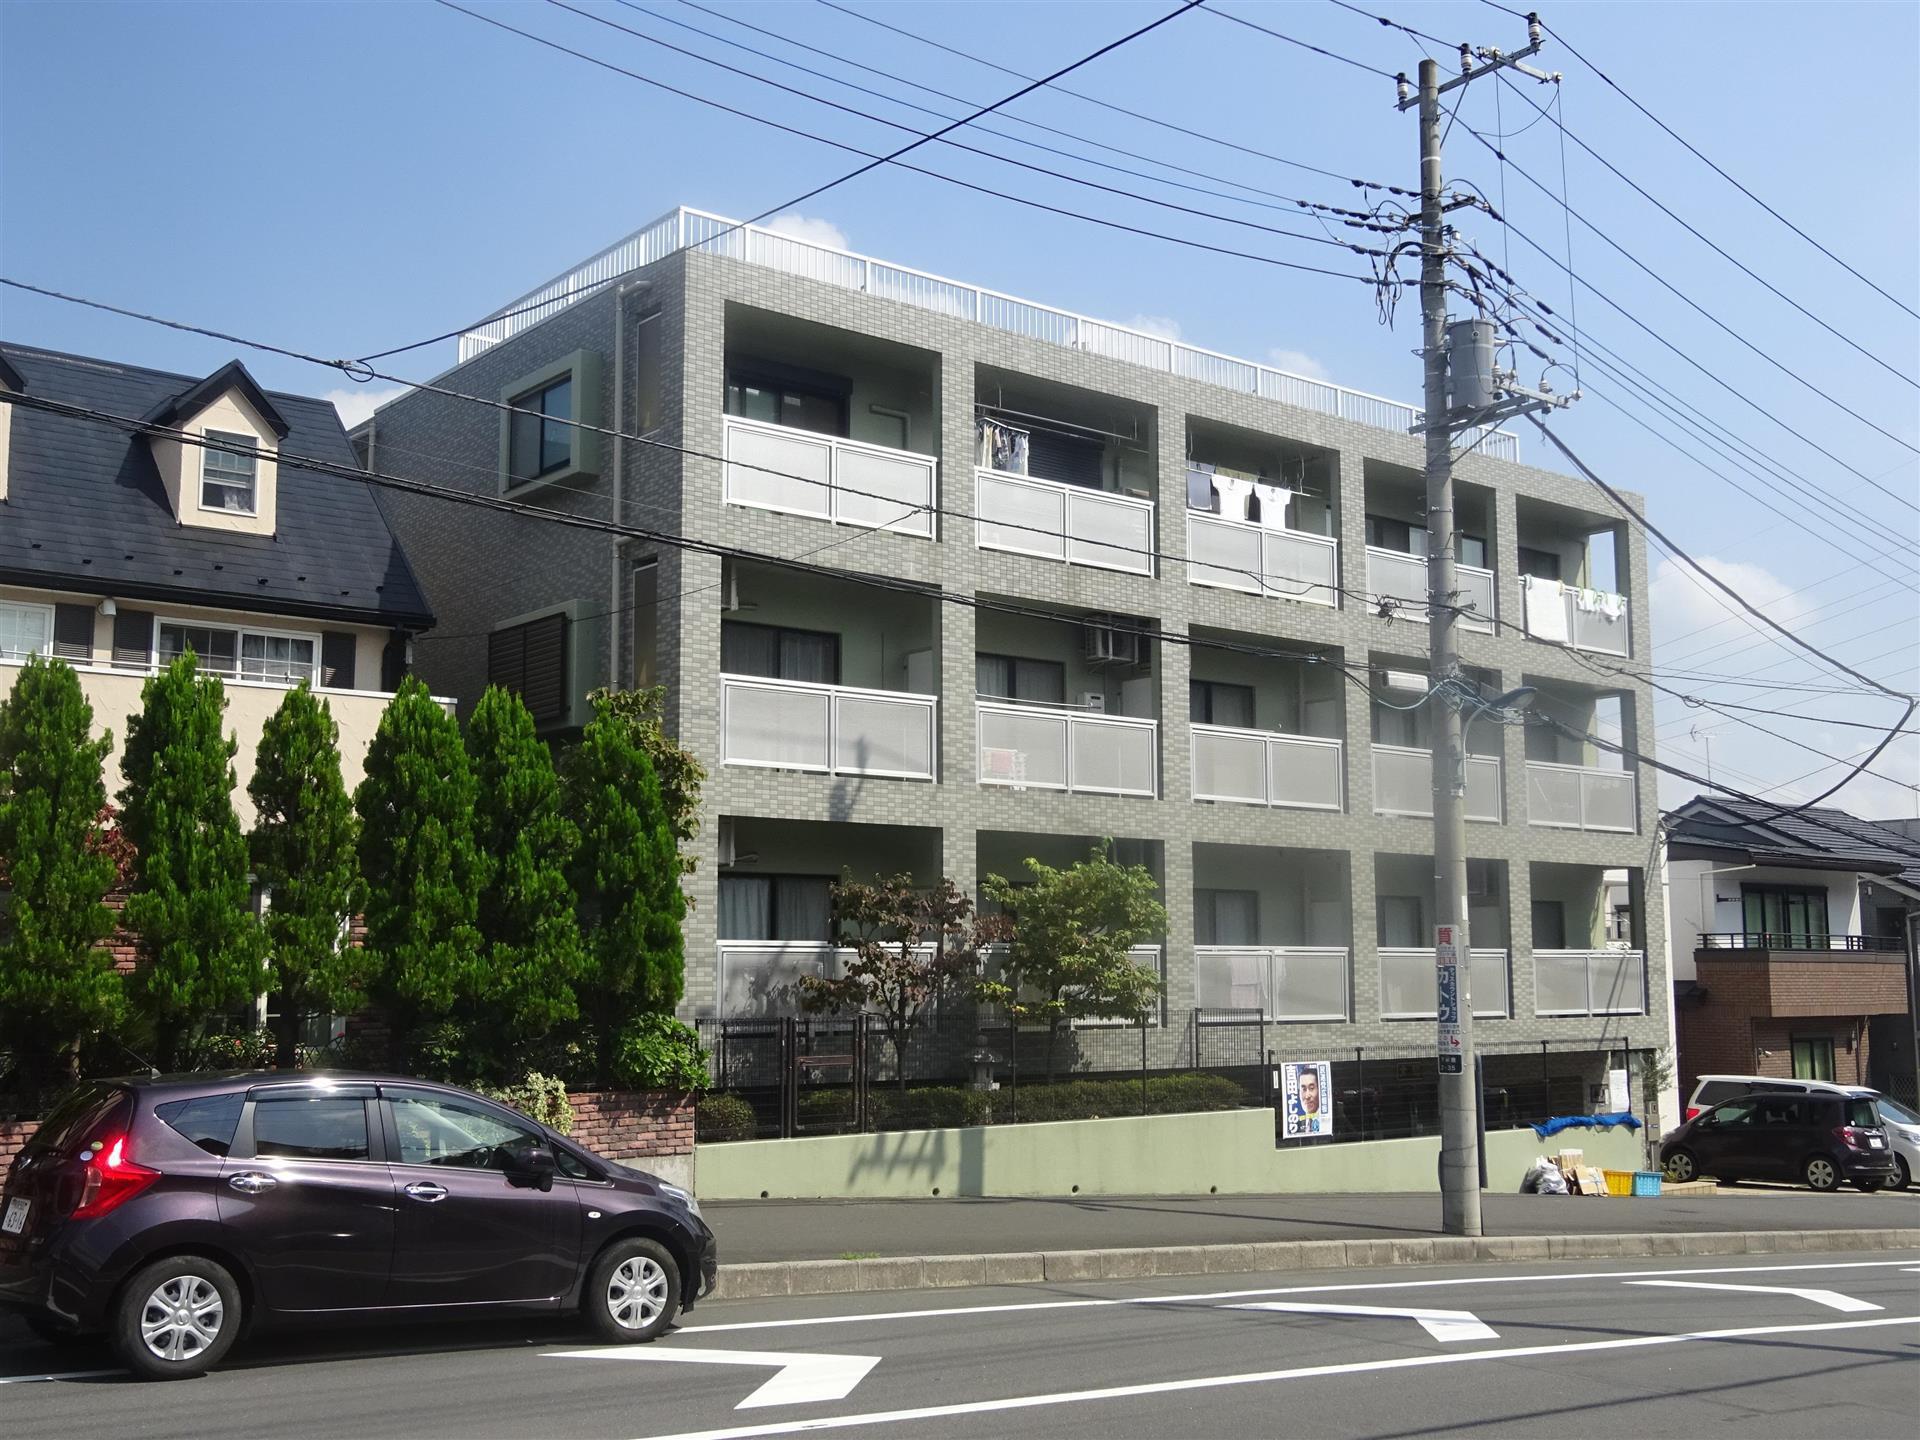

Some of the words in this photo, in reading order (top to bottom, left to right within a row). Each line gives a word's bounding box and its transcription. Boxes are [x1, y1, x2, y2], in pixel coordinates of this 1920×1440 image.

[1438, 967, 1449, 1021] カトウ
[1285, 1065, 1299, 1133] 吉田よしのり
